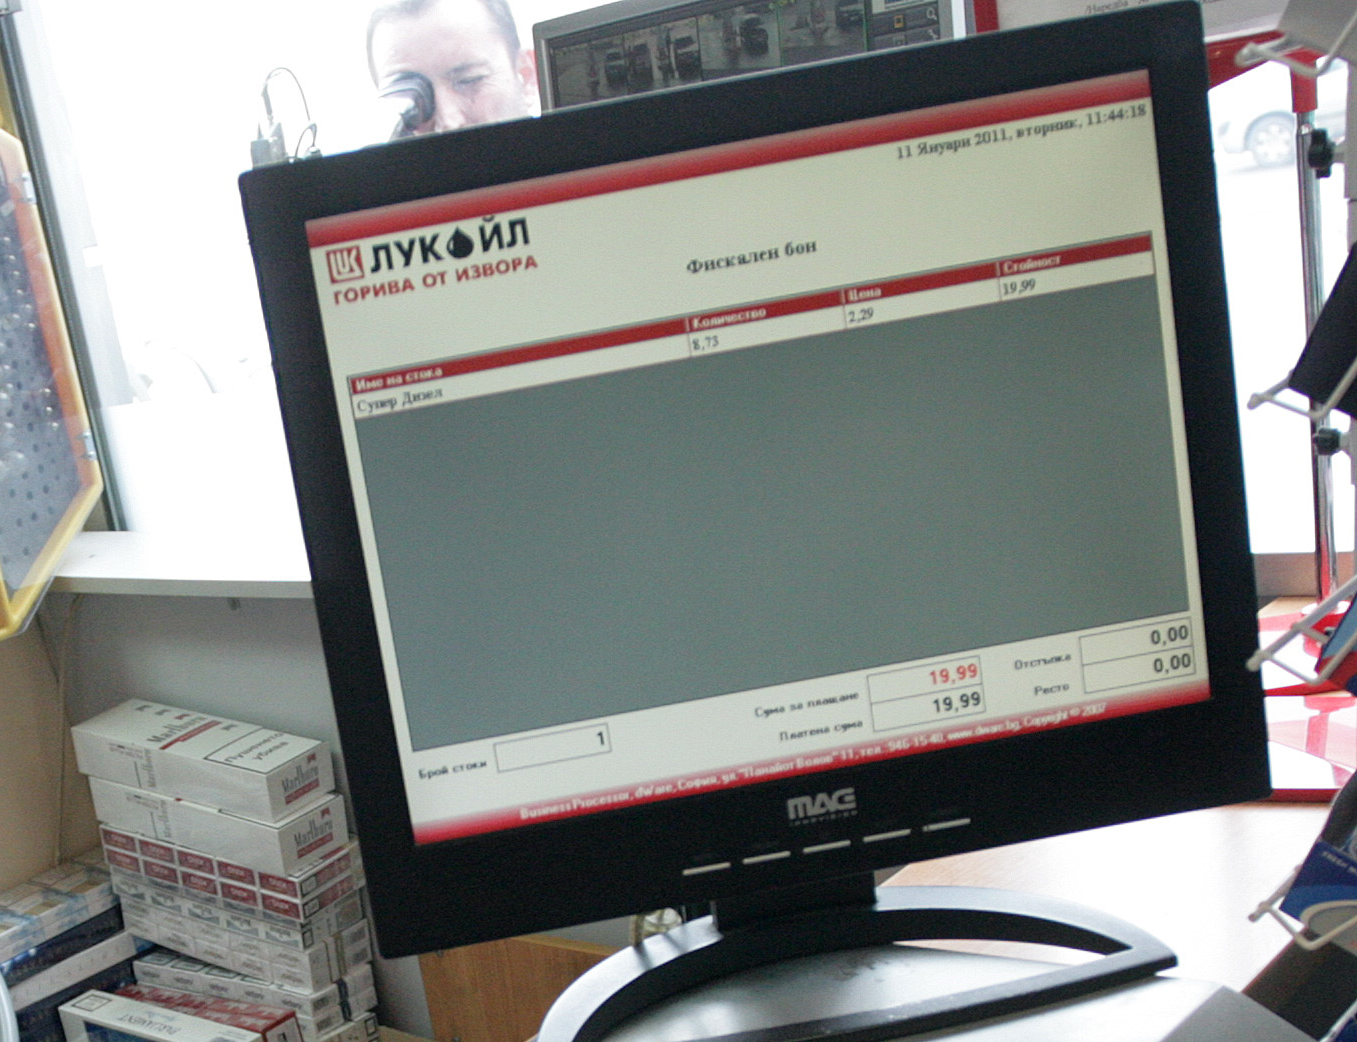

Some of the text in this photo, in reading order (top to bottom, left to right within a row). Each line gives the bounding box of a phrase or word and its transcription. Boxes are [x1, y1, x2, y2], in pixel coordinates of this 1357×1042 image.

[897, 145, 914, 160] 11
[917, 134, 972, 161] Януари
[975, 128, 1013, 147] 2011,
[1086, 103, 1147, 126] 11:44:18
[687, 240, 818, 276] Фискален бон
[1002, 254, 1062, 275] Стойност
[334, 255, 539, 306] ГОРИВА ОТ ИЗВОРА
[1002, 278, 1036, 296] 19,99
[848, 285, 882, 303] Цена
[692, 306, 767, 330] Количество
[848, 307, 874, 324] 2,29
[692, 335, 719, 352] 8,73
[1150, 624, 1189, 646] 0,00
[929, 662, 979, 686] 19,99
[1153, 653, 1192, 675] 0,00
[932, 692, 982, 715] 19,99
[597, 731, 606, 746] 1
[419, 764, 449, 781] Брой
[787, 787, 857, 820] MAG
[294, 812, 333, 847] Marlboro
